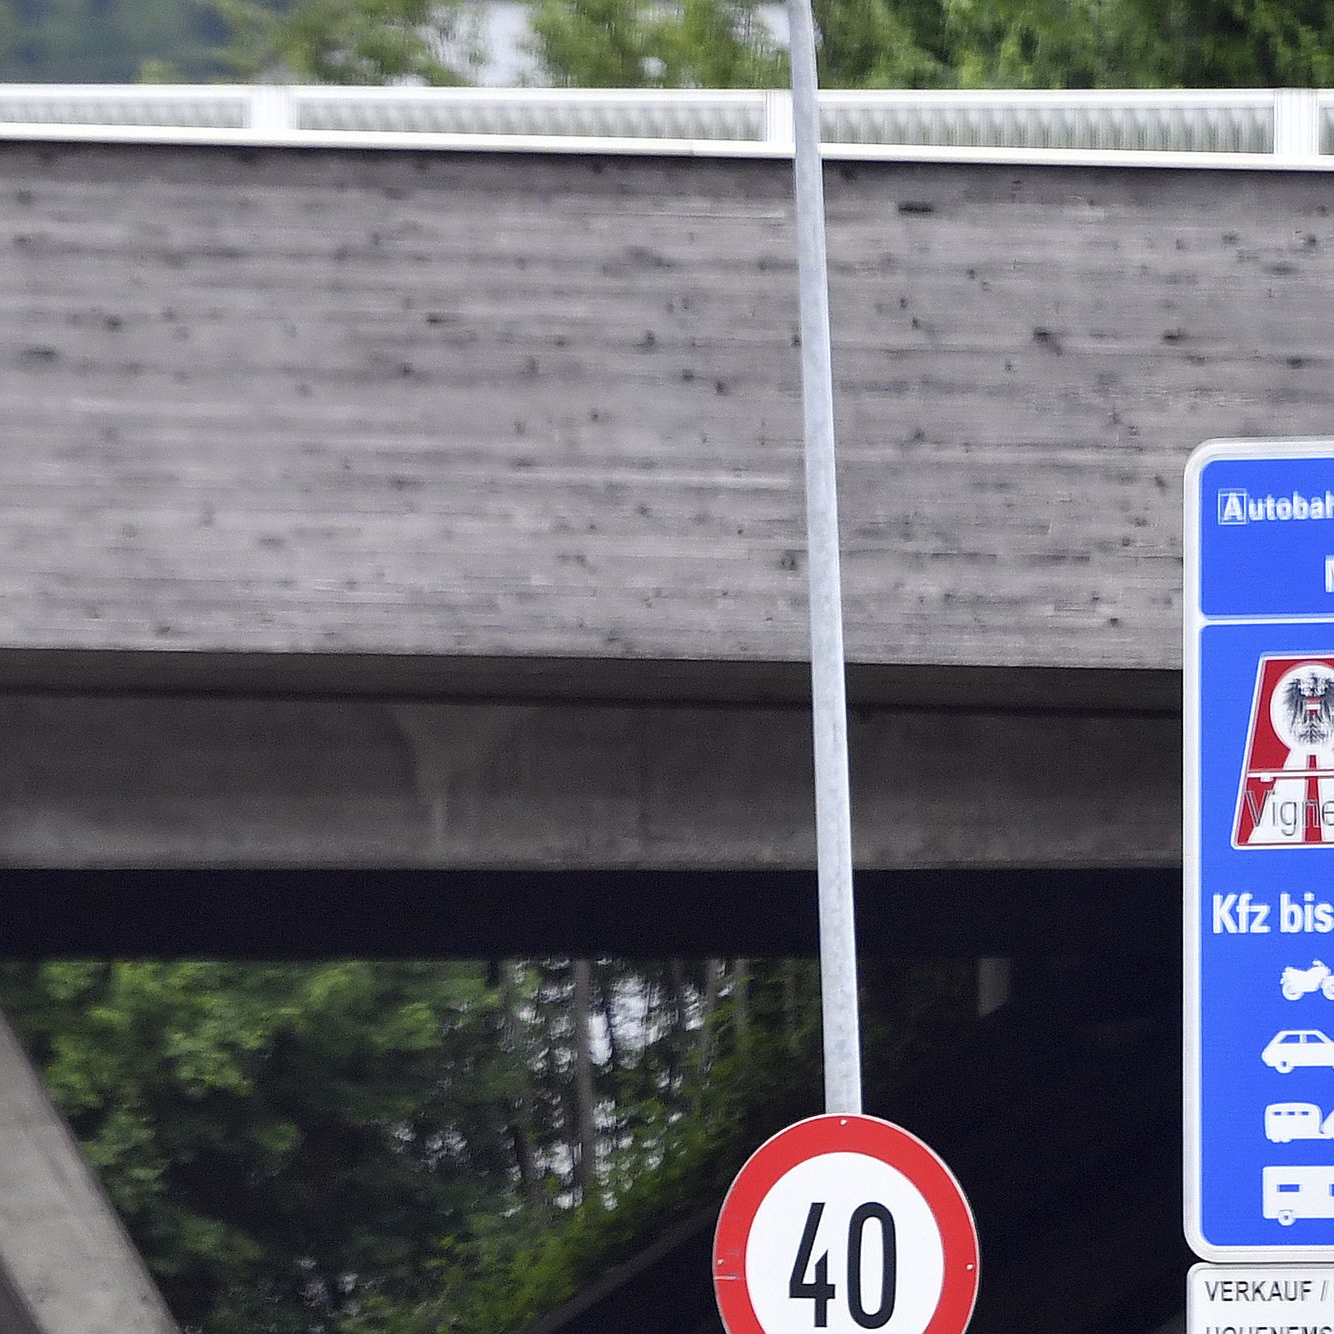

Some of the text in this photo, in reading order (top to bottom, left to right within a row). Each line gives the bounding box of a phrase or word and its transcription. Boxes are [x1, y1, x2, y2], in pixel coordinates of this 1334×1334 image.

[1212, 893, 1271, 934] Kfz
[1280, 893, 1334, 934] bis
[789, 1202, 897, 1329] 40
[1205, 1281, 1313, 1302] VERKAUF
